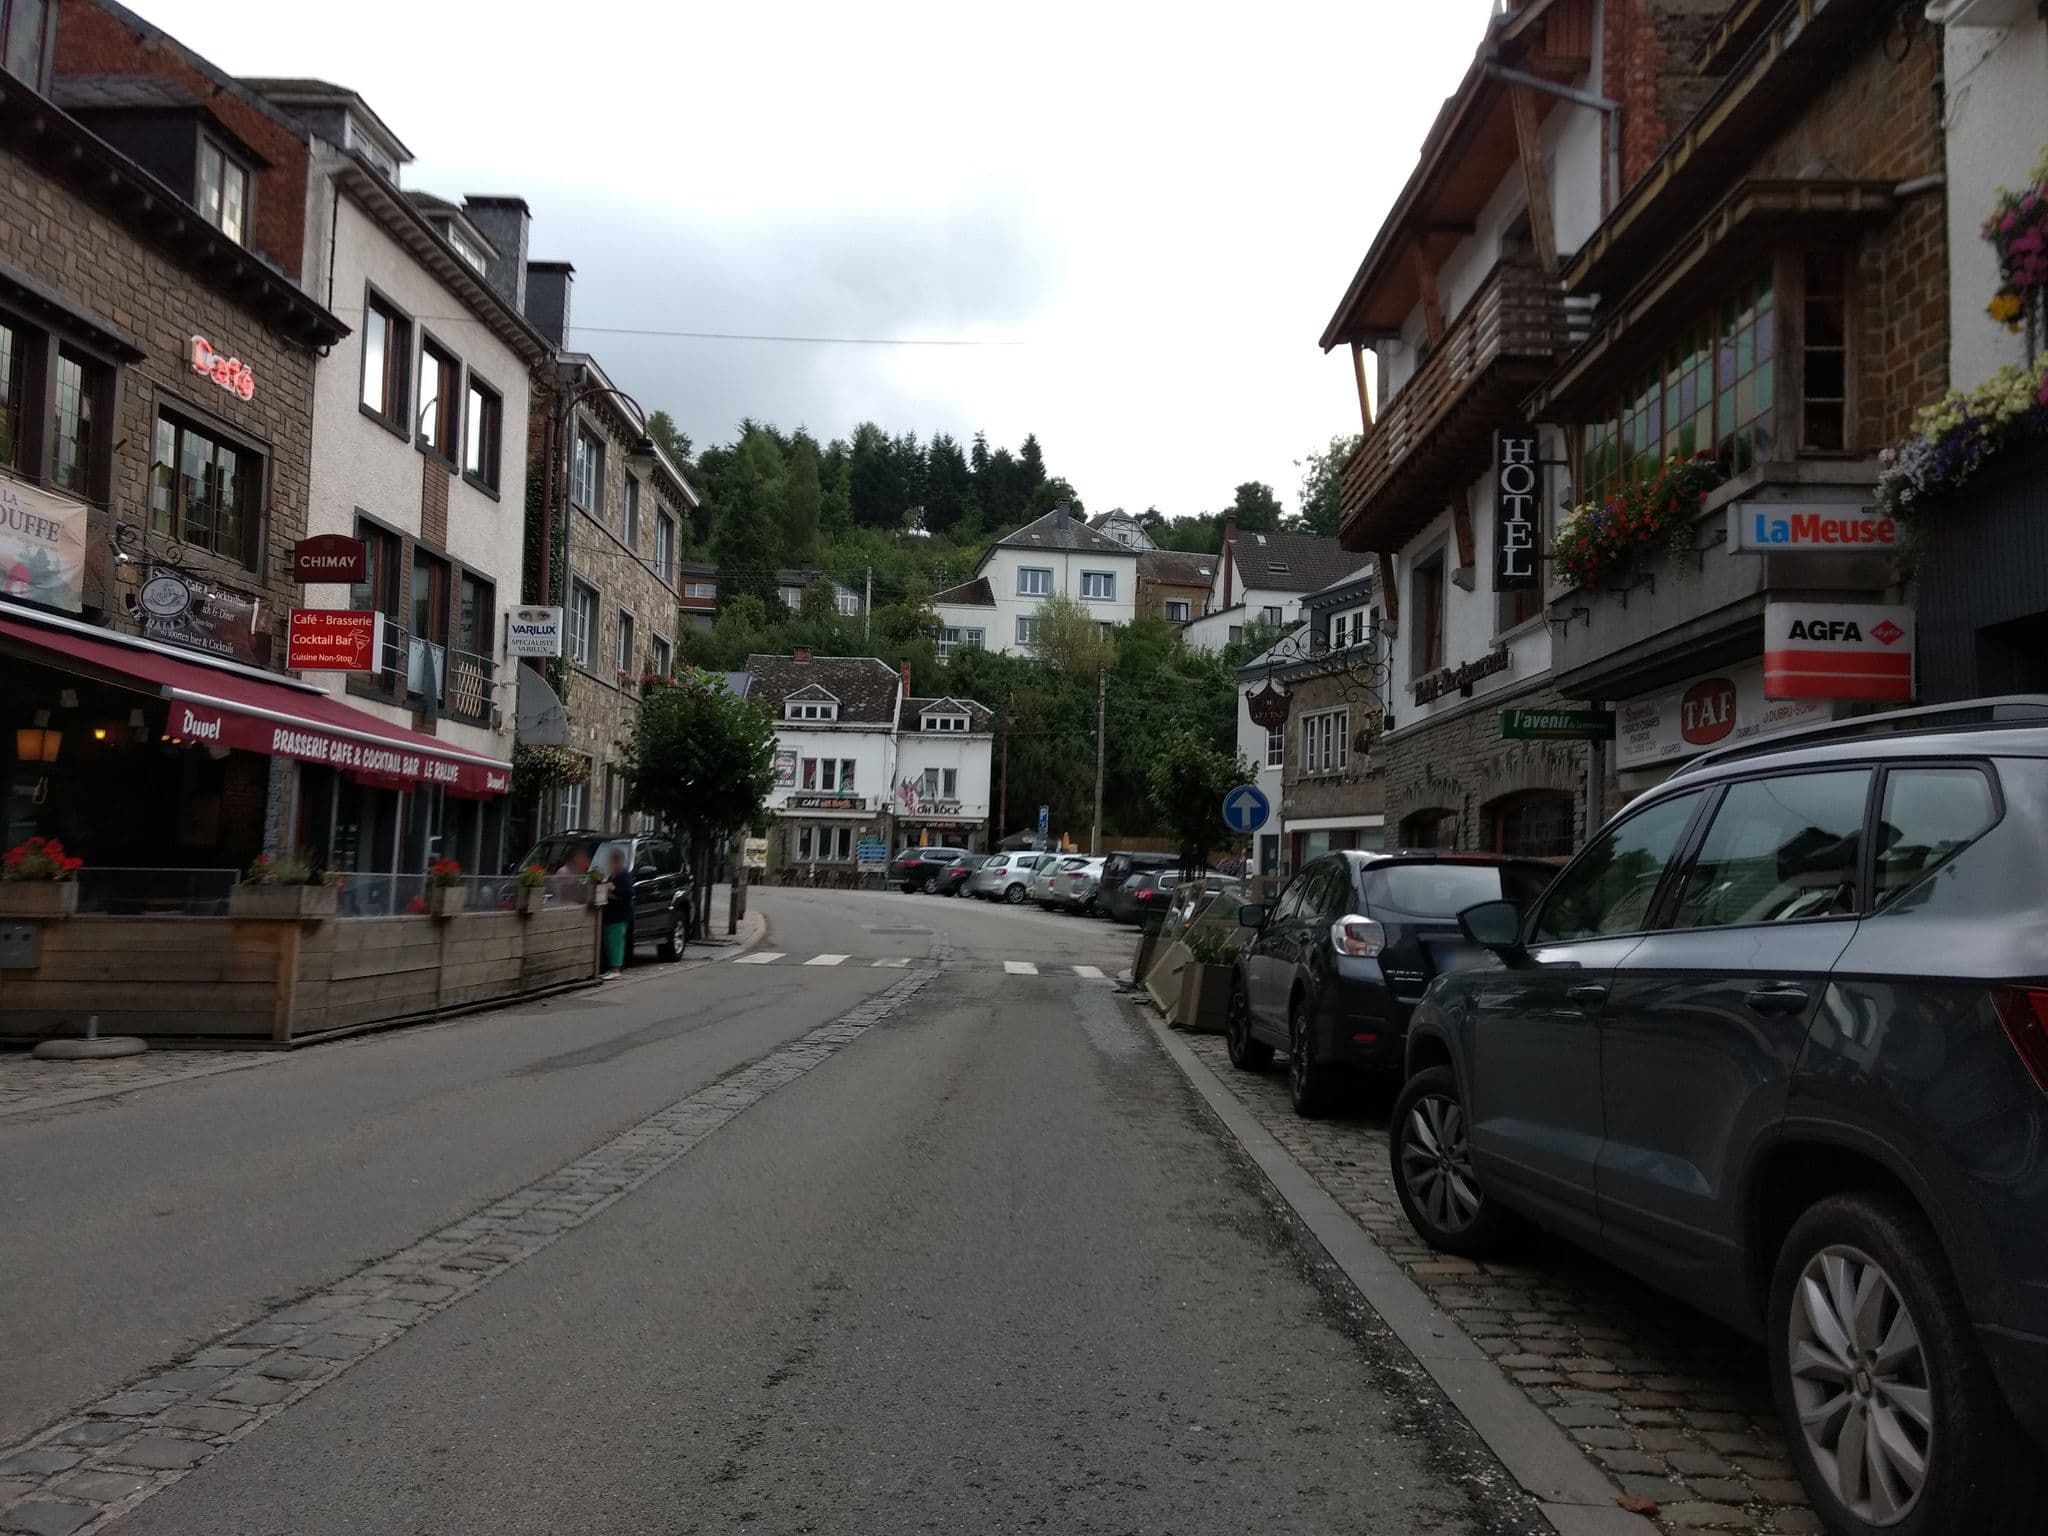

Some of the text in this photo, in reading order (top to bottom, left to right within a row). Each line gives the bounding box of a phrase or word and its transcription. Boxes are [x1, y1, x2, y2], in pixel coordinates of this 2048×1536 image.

[3, 489, 18, 505] LA
[1501, 438, 1535, 576] HOTEL
[300, 555, 357, 568] CHIMAY
[293, 614, 317, 625] Café
[326, 615, 373, 626] Brasserie
[512, 625, 556, 635] VARILUX
[1788, 620, 1863, 642] AGFA
[292, 633, 353, 646] Cocktail Bar
[291, 652, 353, 663] Cuisine Non-Stop
[1513, 709, 1571, 729] l'avenir
[1684, 691, 1732, 730] TAF
[182, 708, 221, 740] Duvel
[272, 728, 460, 782] BRASSERIE CAFE & COCKTAIL BAR LE RALLYE
